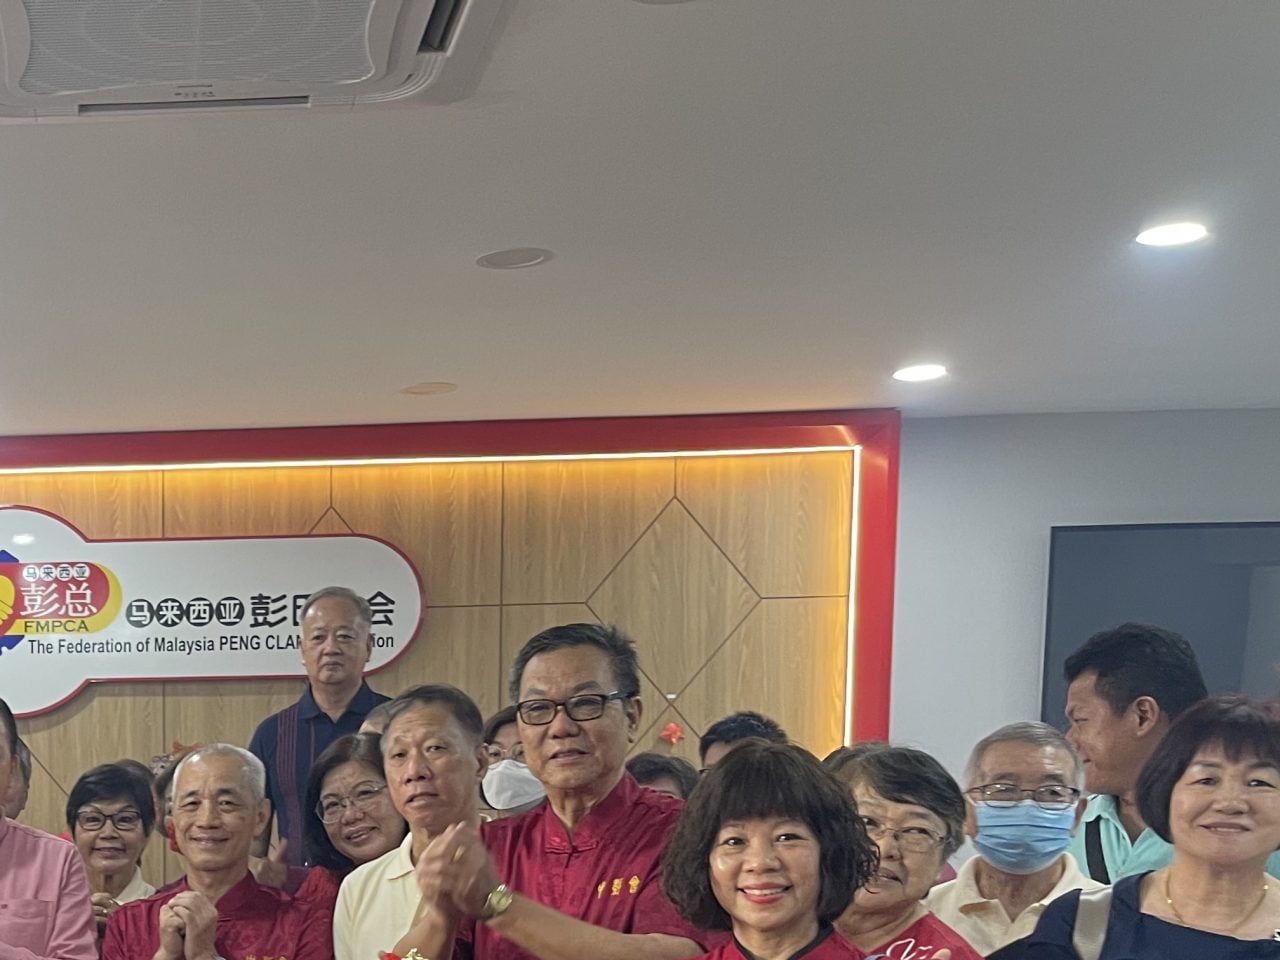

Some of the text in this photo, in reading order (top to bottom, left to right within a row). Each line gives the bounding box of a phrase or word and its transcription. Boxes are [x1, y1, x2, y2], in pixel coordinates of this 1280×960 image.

[23, 564, 89, 581] 马来西亚
[20, 583, 98, 617] 彭总
[24, 620, 89, 633] FMPCA
[28, 639, 54, 654] The
[58, 637, 131, 653] Federation
[136, 637, 150, 652] of
[154, 636, 214, 655] Malaysia
[220, 635, 260, 650] PENG
